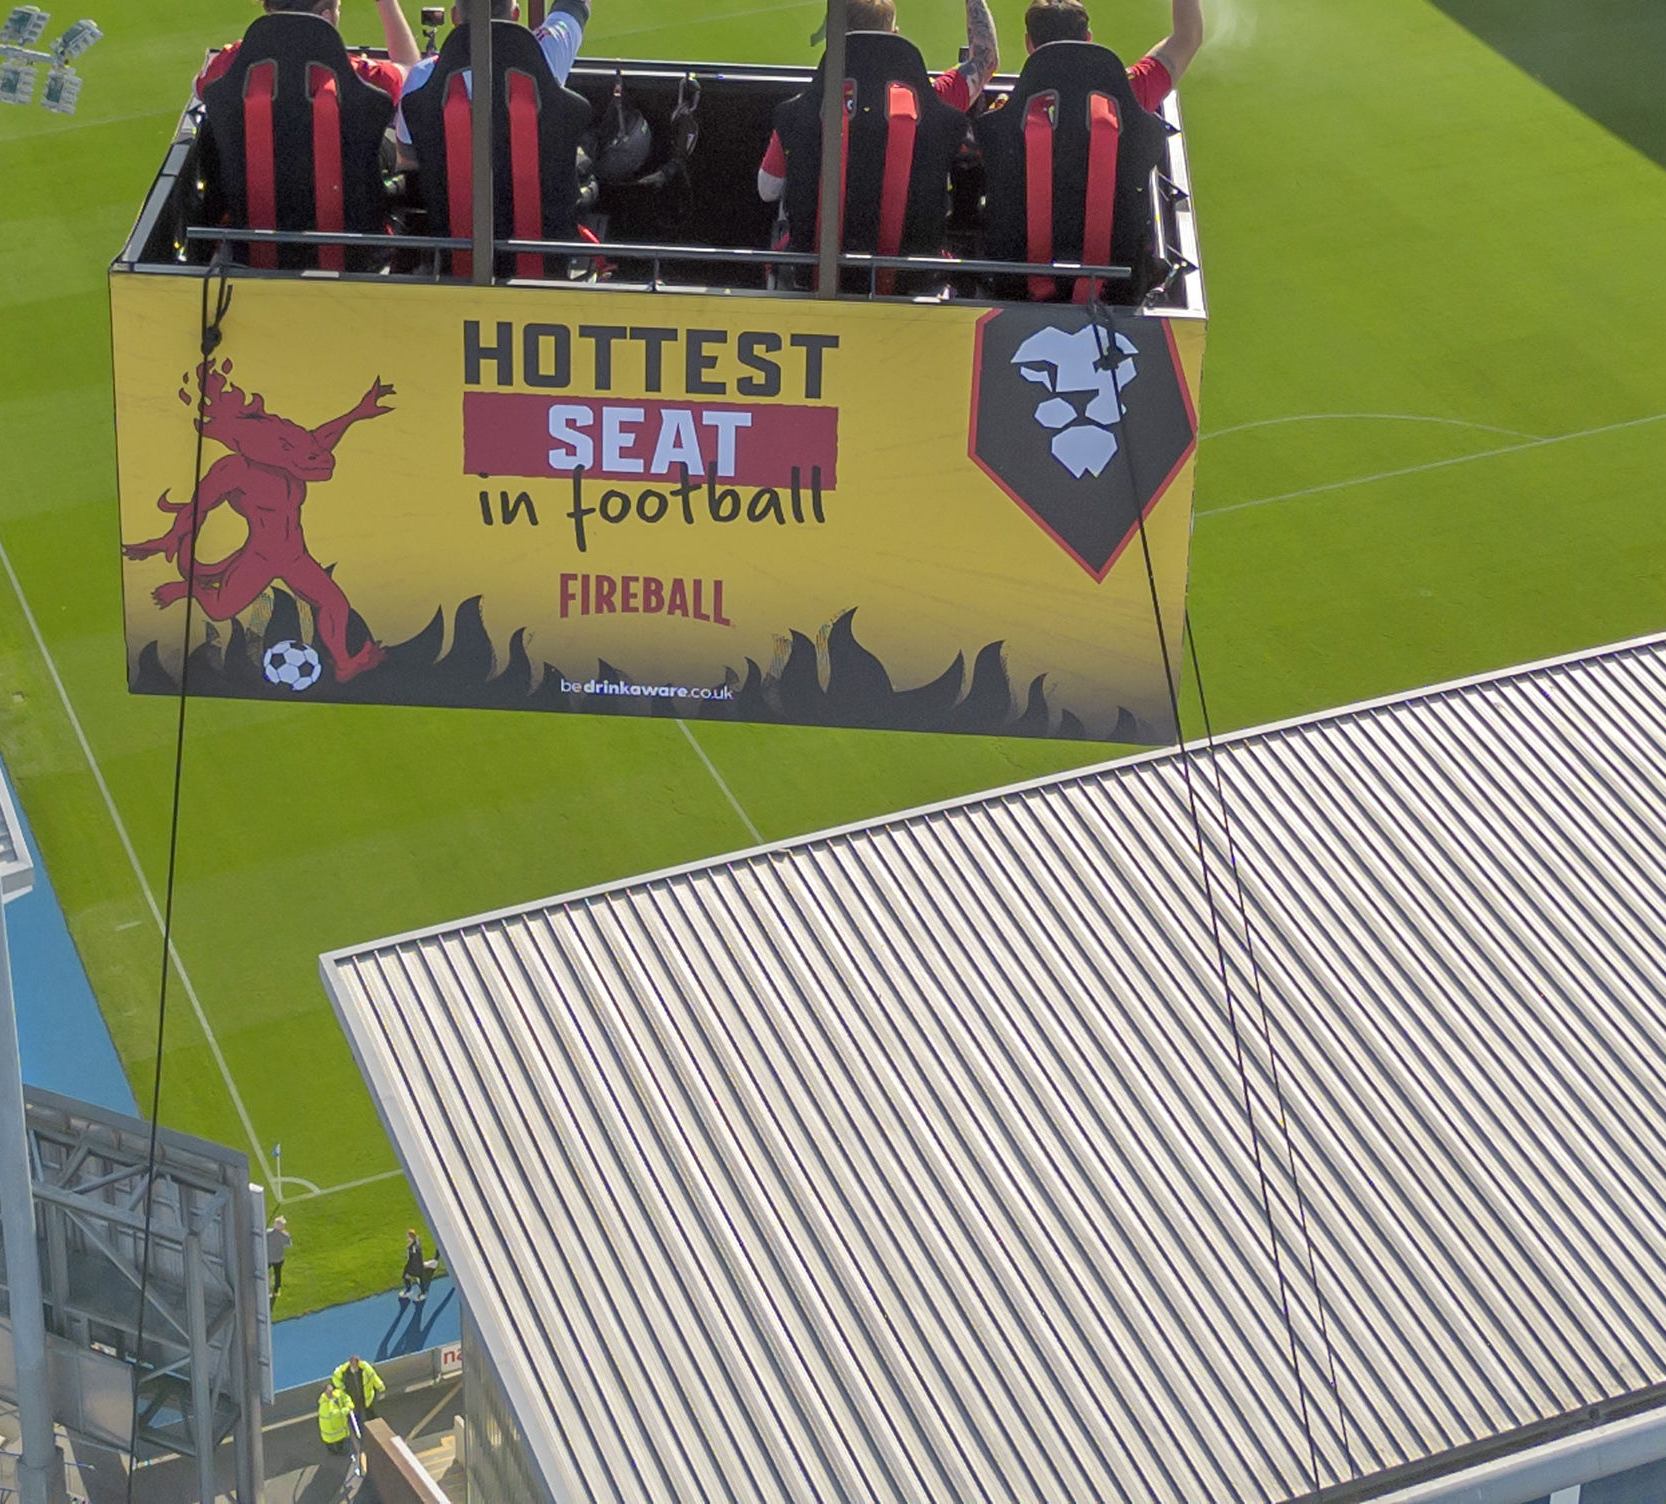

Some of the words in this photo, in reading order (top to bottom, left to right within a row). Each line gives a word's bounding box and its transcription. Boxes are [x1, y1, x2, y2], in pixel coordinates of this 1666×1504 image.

[463, 320, 840, 399] HOTTEST
[548, 404, 753, 478] SEAT
[478, 472, 539, 527] in
[566, 460, 826, 553] football
[558, 572, 732, 627] FIREBALL
[560, 678, 734, 701] bedrinkaware.co.uk
